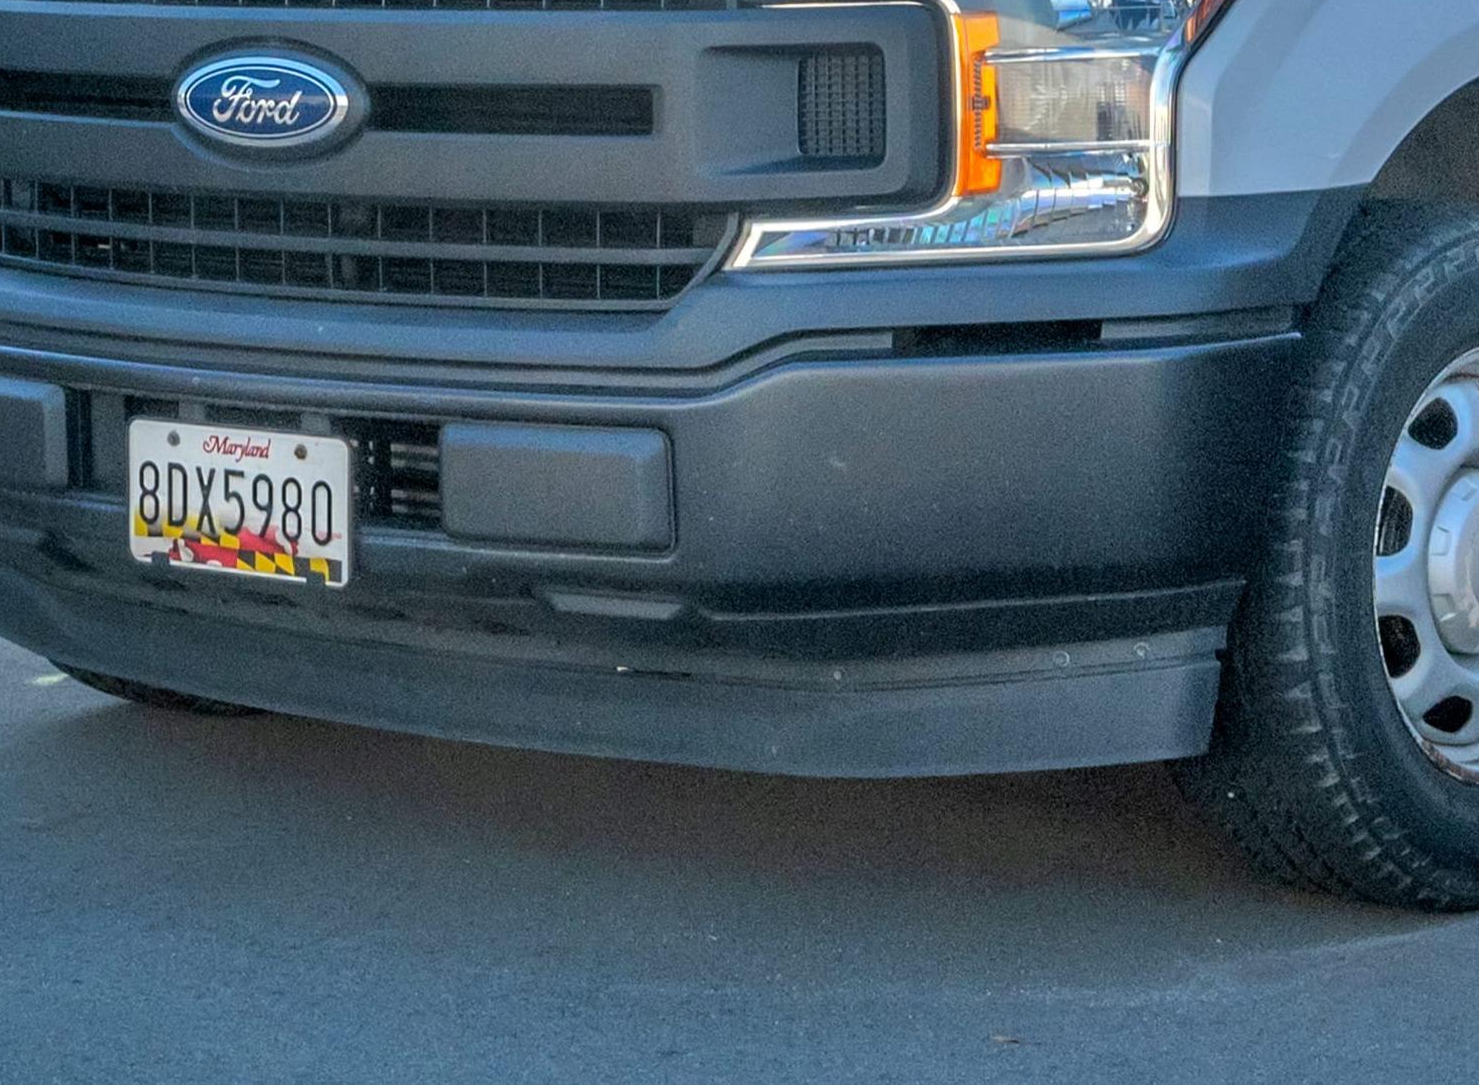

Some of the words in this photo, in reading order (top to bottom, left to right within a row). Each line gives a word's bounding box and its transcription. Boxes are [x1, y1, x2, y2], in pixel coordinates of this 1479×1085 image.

[212, 75, 302, 125] Ford
[202, 435, 271, 463] Maryland
[139, 460, 333, 546] 8DX5980
